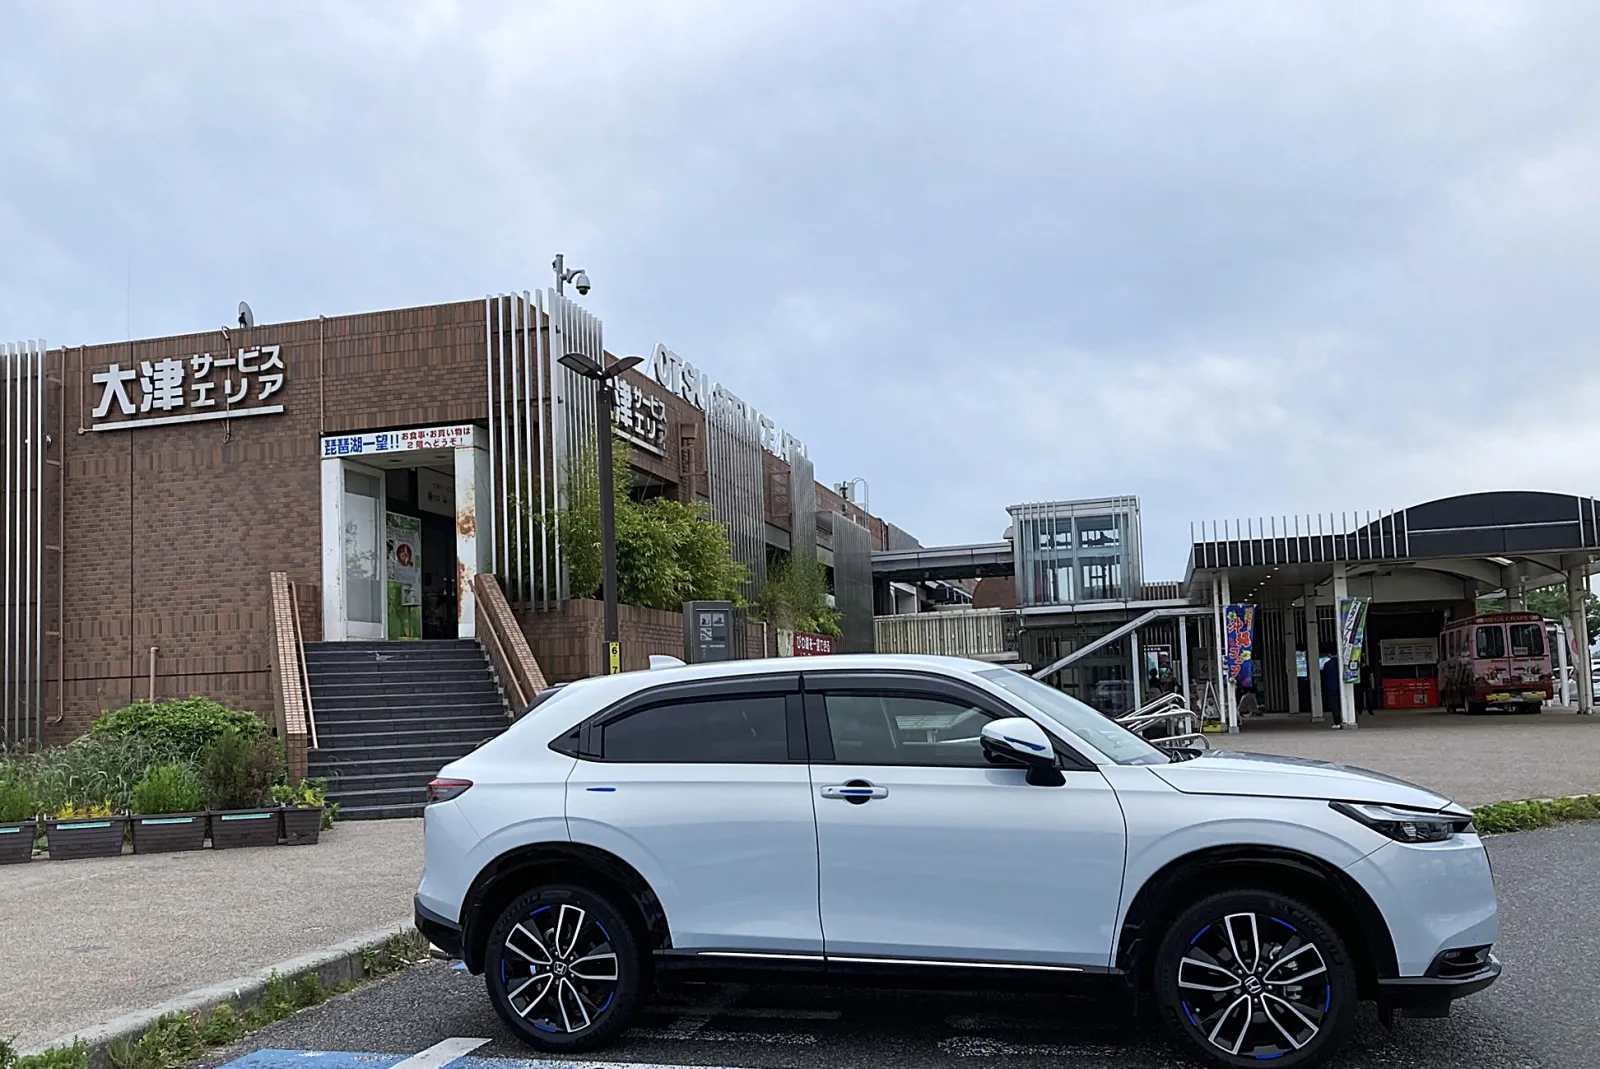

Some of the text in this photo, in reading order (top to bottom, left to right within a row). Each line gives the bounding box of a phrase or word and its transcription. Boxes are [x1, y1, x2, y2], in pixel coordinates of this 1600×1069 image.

[190, 345, 285, 379] サービス
[654, 342, 708, 410] OTSU
[92, 357, 185, 418] 大津
[190, 373, 284, 408] エリア
[633, 386, 667, 424] サービス
